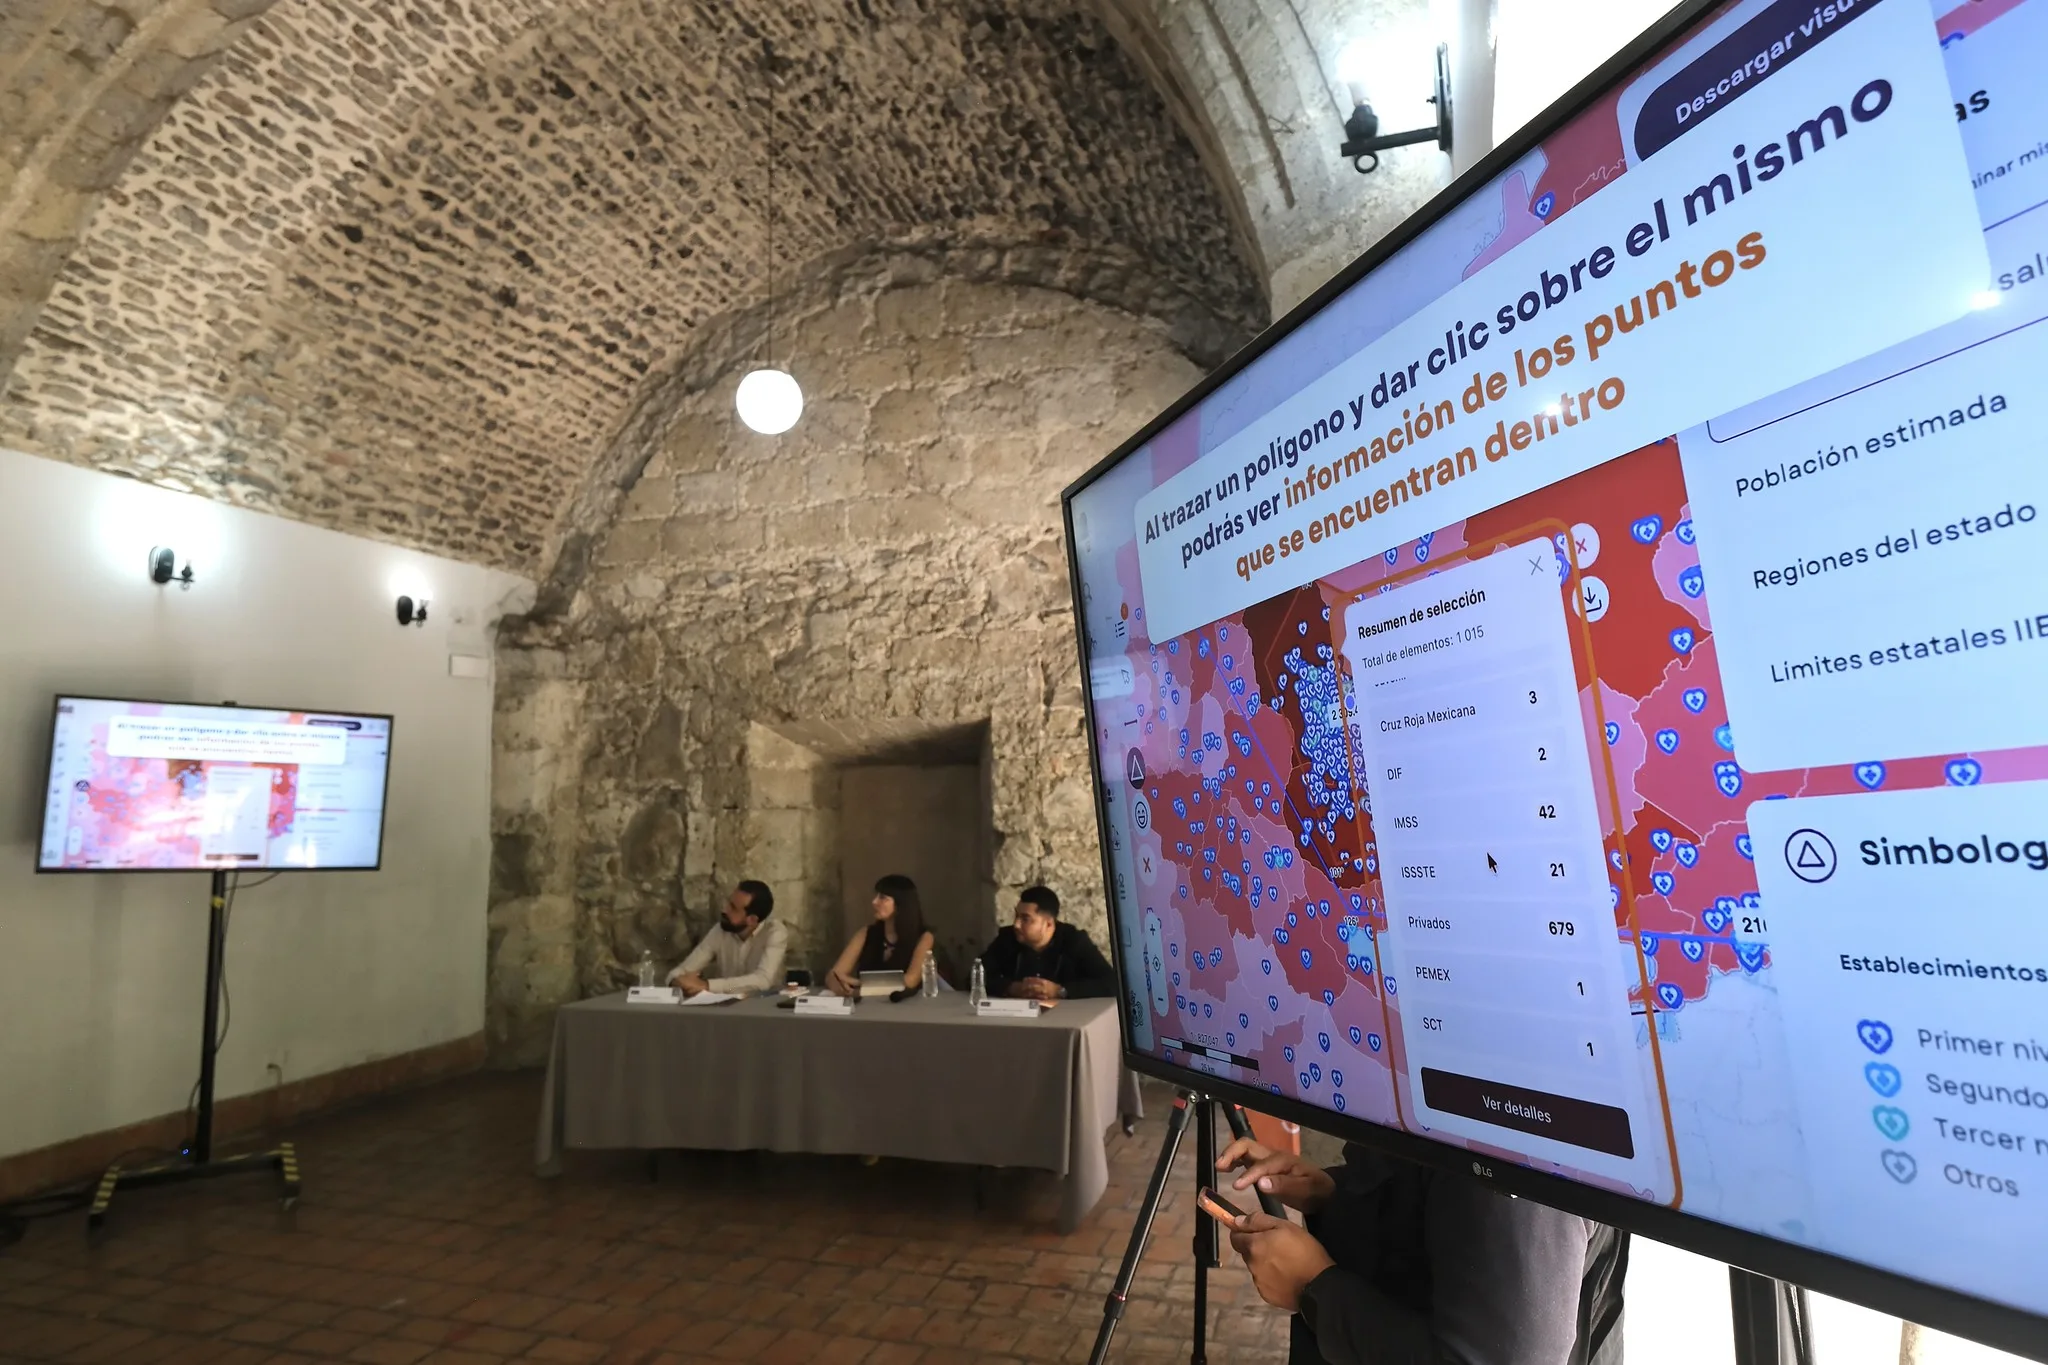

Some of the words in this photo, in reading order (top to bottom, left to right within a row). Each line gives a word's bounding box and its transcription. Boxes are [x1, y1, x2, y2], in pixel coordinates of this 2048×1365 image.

[1675, 30, 1796, 124] Descargar
[1799, 0, 1860, 37] visu
[1998, 252, 2048, 291] sal
[1145, 517, 1160, 544] Al
[1162, 487, 1212, 532] trazar
[1217, 473, 1240, 503] un
[1244, 412, 1345, 487] polígono
[1348, 393, 1365, 429] y
[1372, 359, 1420, 409] dar
[1427, 319, 1490, 376] clic
[1497, 244, 1616, 334] sobre
[1625, 197, 1671, 257] el
[1683, 78, 1893, 226] mismo
[1181, 511, 1244, 569] podrás
[1247, 494, 1281, 526] ver
[1284, 400, 1456, 508] información
[1461, 371, 1508, 414] de
[1514, 332, 1576, 387] los
[1584, 230, 1767, 361] puntos
[1735, 445, 1858, 497] Población
[1865, 394, 2008, 454] estimada
[1235, 549, 1276, 583] que
[1279, 530, 1305, 558] se
[1309, 440, 1478, 543] encuentran
[1485, 376, 1626, 463] dentro
[1753, 547, 1868, 589] Regiones
[1875, 529, 1918, 558] del
[1926, 503, 2036, 546] estado
[1358, 614, 1407, 640] Resumen
[1409, 608, 1424, 623] de
[1427, 588, 1486, 619] selección
[1362, 653, 1384, 669] Total
[1385, 648, 1397, 665] de
[1399, 635, 1454, 660] elementos:
[1770, 652, 1862, 683] Límites
[1869, 628, 2007, 666] estatales
[1380, 717, 1402, 732] Cruz
[1404, 713, 1426, 729] Roja
[1427, 703, 1476, 725] Mexicana
[1529, 690, 1537, 704] 3
[1387, 767, 1402, 780] DIF
[1538, 748, 1547, 761] 2
[1394, 816, 1418, 829] IMSS
[1539, 805, 1556, 819] 42
[1401, 865, 1435, 879] ISSSTE
[1550, 863, 1565, 877] 21
[1408, 916, 1451, 930] Privados
[1549, 921, 1575, 936] 679
[1742, 917, 1767, 934] 21
[1415, 966, 1450, 982] PEMEX
[1577, 981, 1585, 996] 1
[1841, 955, 2048, 983] Establecimientos
[1423, 1017, 1443, 1032] SCT
[1586, 1042, 1594, 1057] 1
[1917, 1028, 2005, 1058] Primer
[1926, 1074, 2048, 1109] Segundo
[1482, 1096, 1500, 1109] Ver
[1504, 1100, 1552, 1123] detalles
[1934, 1118, 2026, 1152] Tercer
[1482, 1166, 1493, 1178] LG
[1943, 1164, 2020, 1197] Otros
